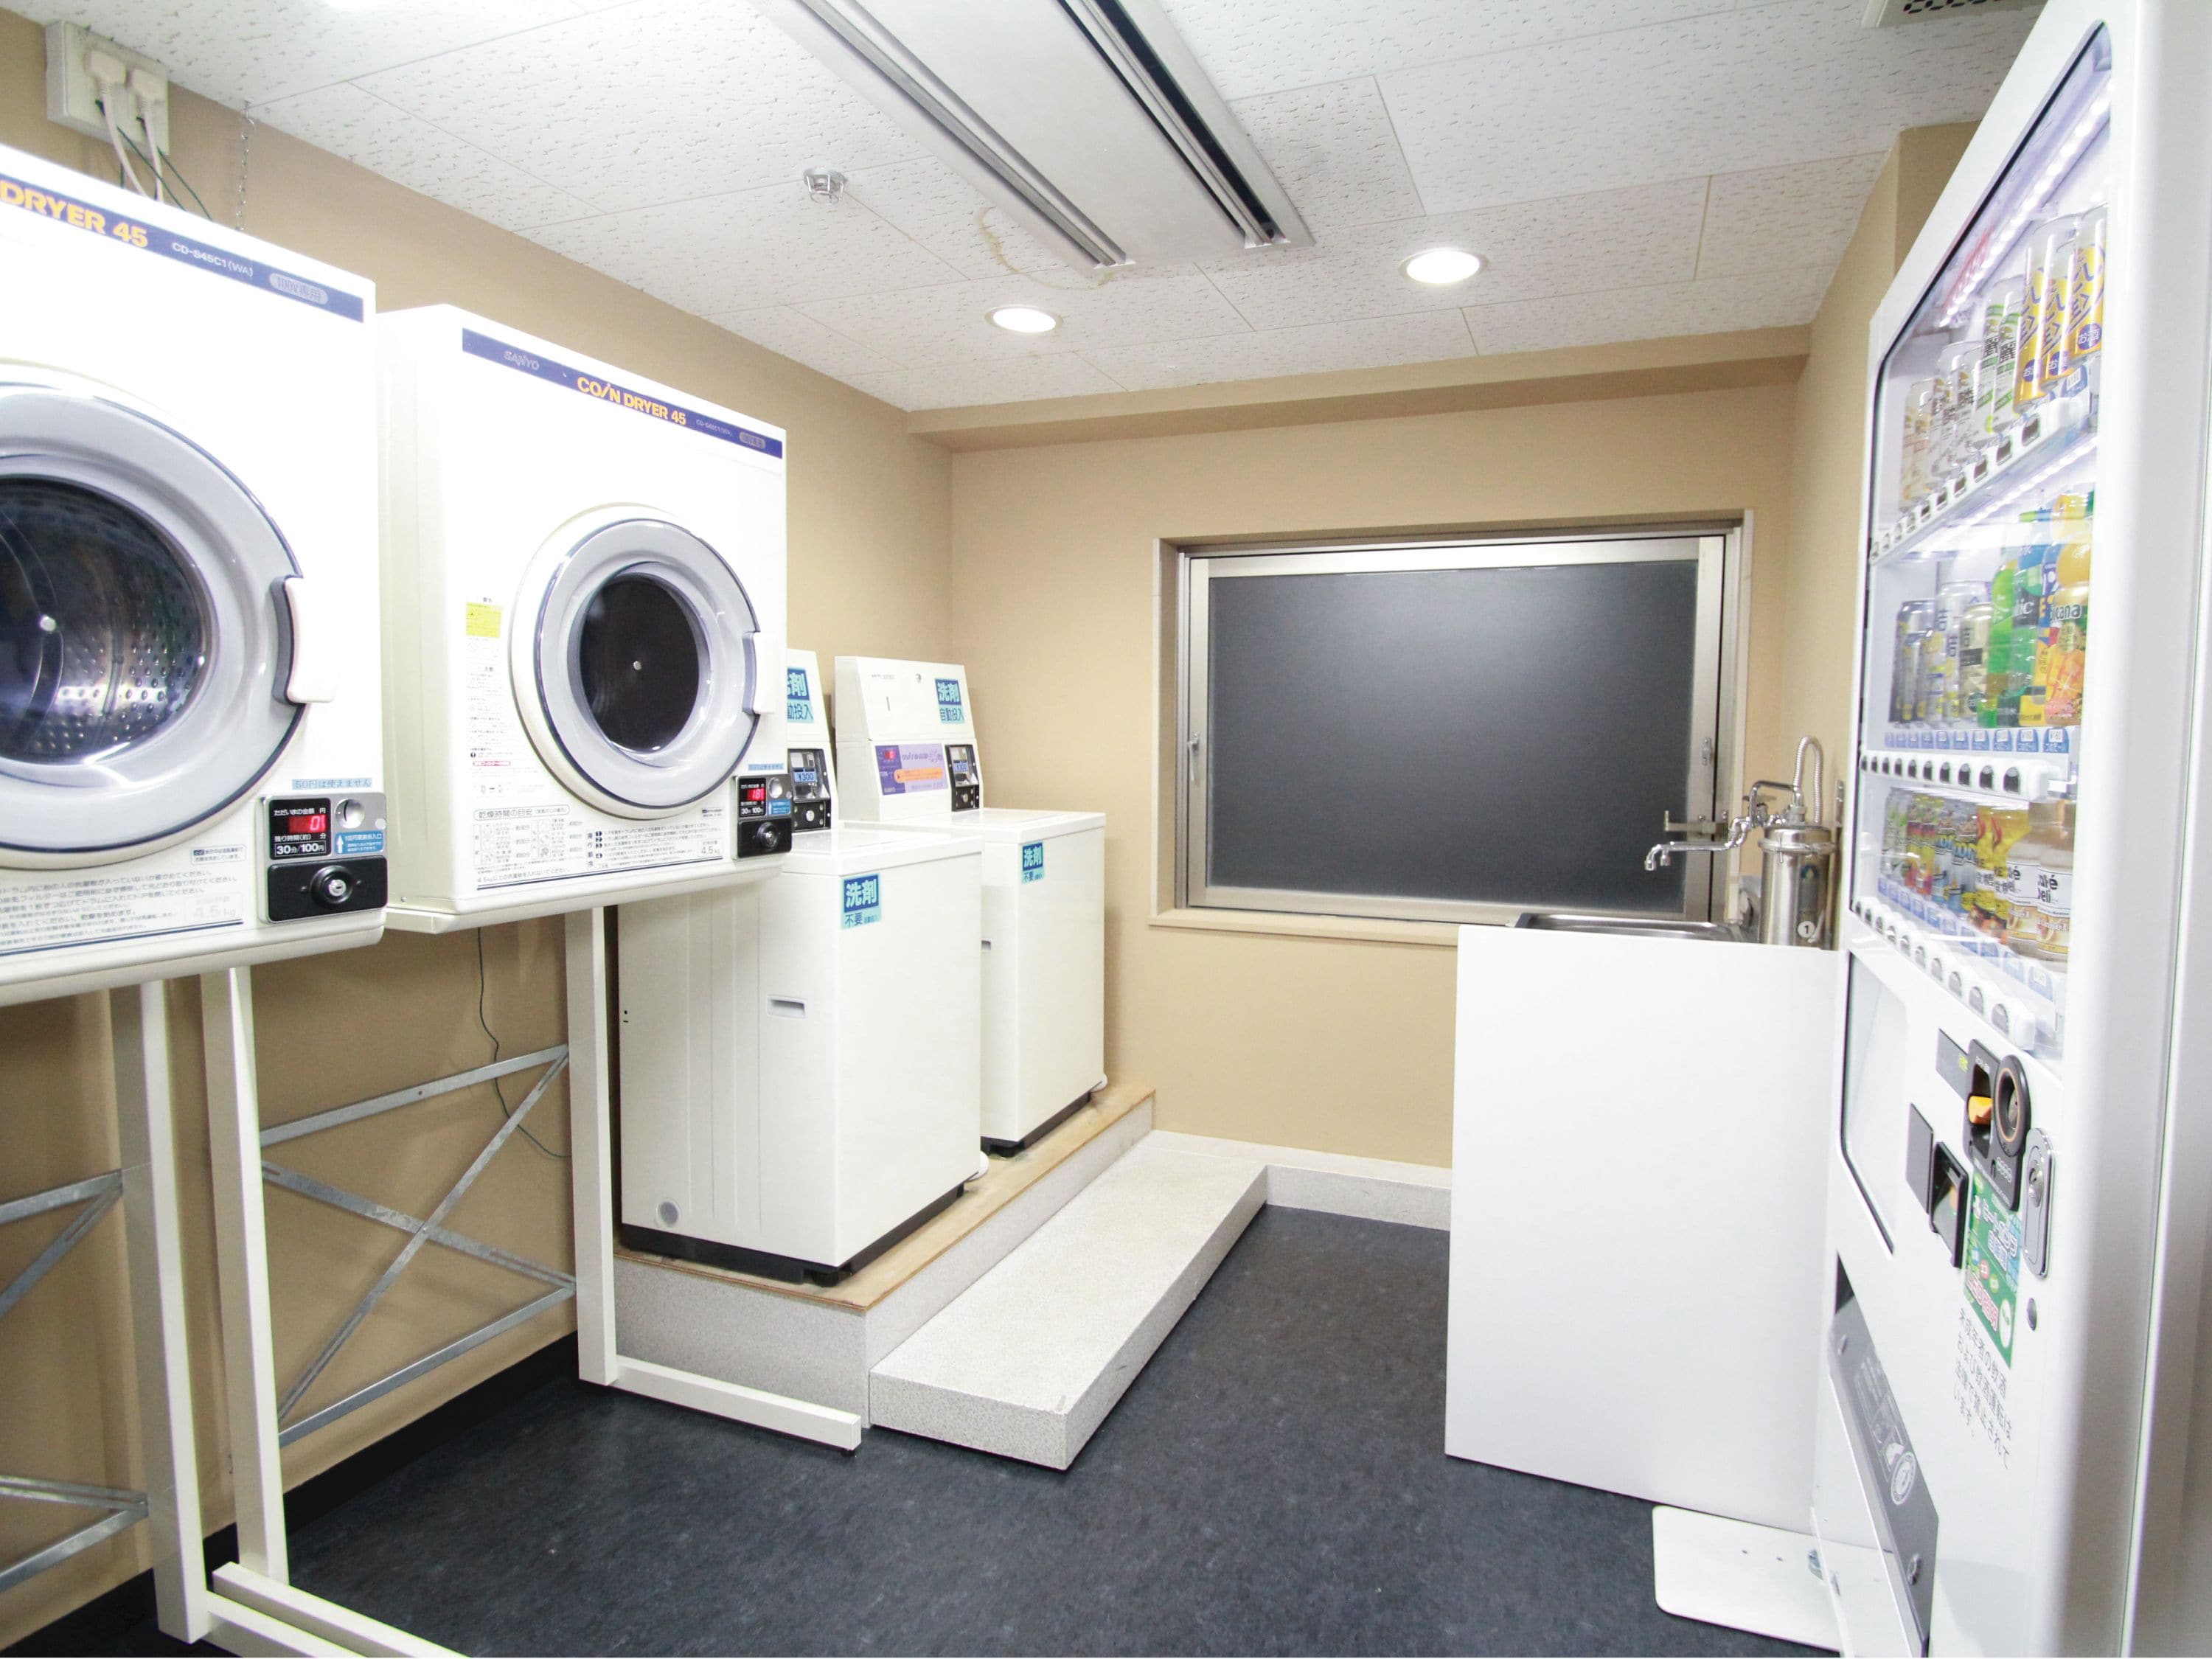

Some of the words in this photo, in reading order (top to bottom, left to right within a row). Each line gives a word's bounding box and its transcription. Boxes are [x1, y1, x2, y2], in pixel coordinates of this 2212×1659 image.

[0, 181, 106, 234] DRYER
[113, 221, 147, 248] 45
[504, 349, 540, 371] SANYO
[624, 392, 668, 420] DRYER
[671, 410, 686, 425] 45
[937, 681, 960, 703] 洗剤
[939, 708, 964, 721] 自動投入
[294, 779, 370, 789] 50円は使えません
[479, 808, 532, 818] 乾燥時間の目安
[1023, 845, 1043, 868] 洗剤
[846, 878, 877, 907] 洗剤
[845, 912, 863, 927] 不要
[1958, 1307, 2007, 1399] 未成年者の飲酒
[1958, 1334, 2012, 1441] および飲酒運転は
[1955, 1360, 2010, 1470] 法律で禁止されて
